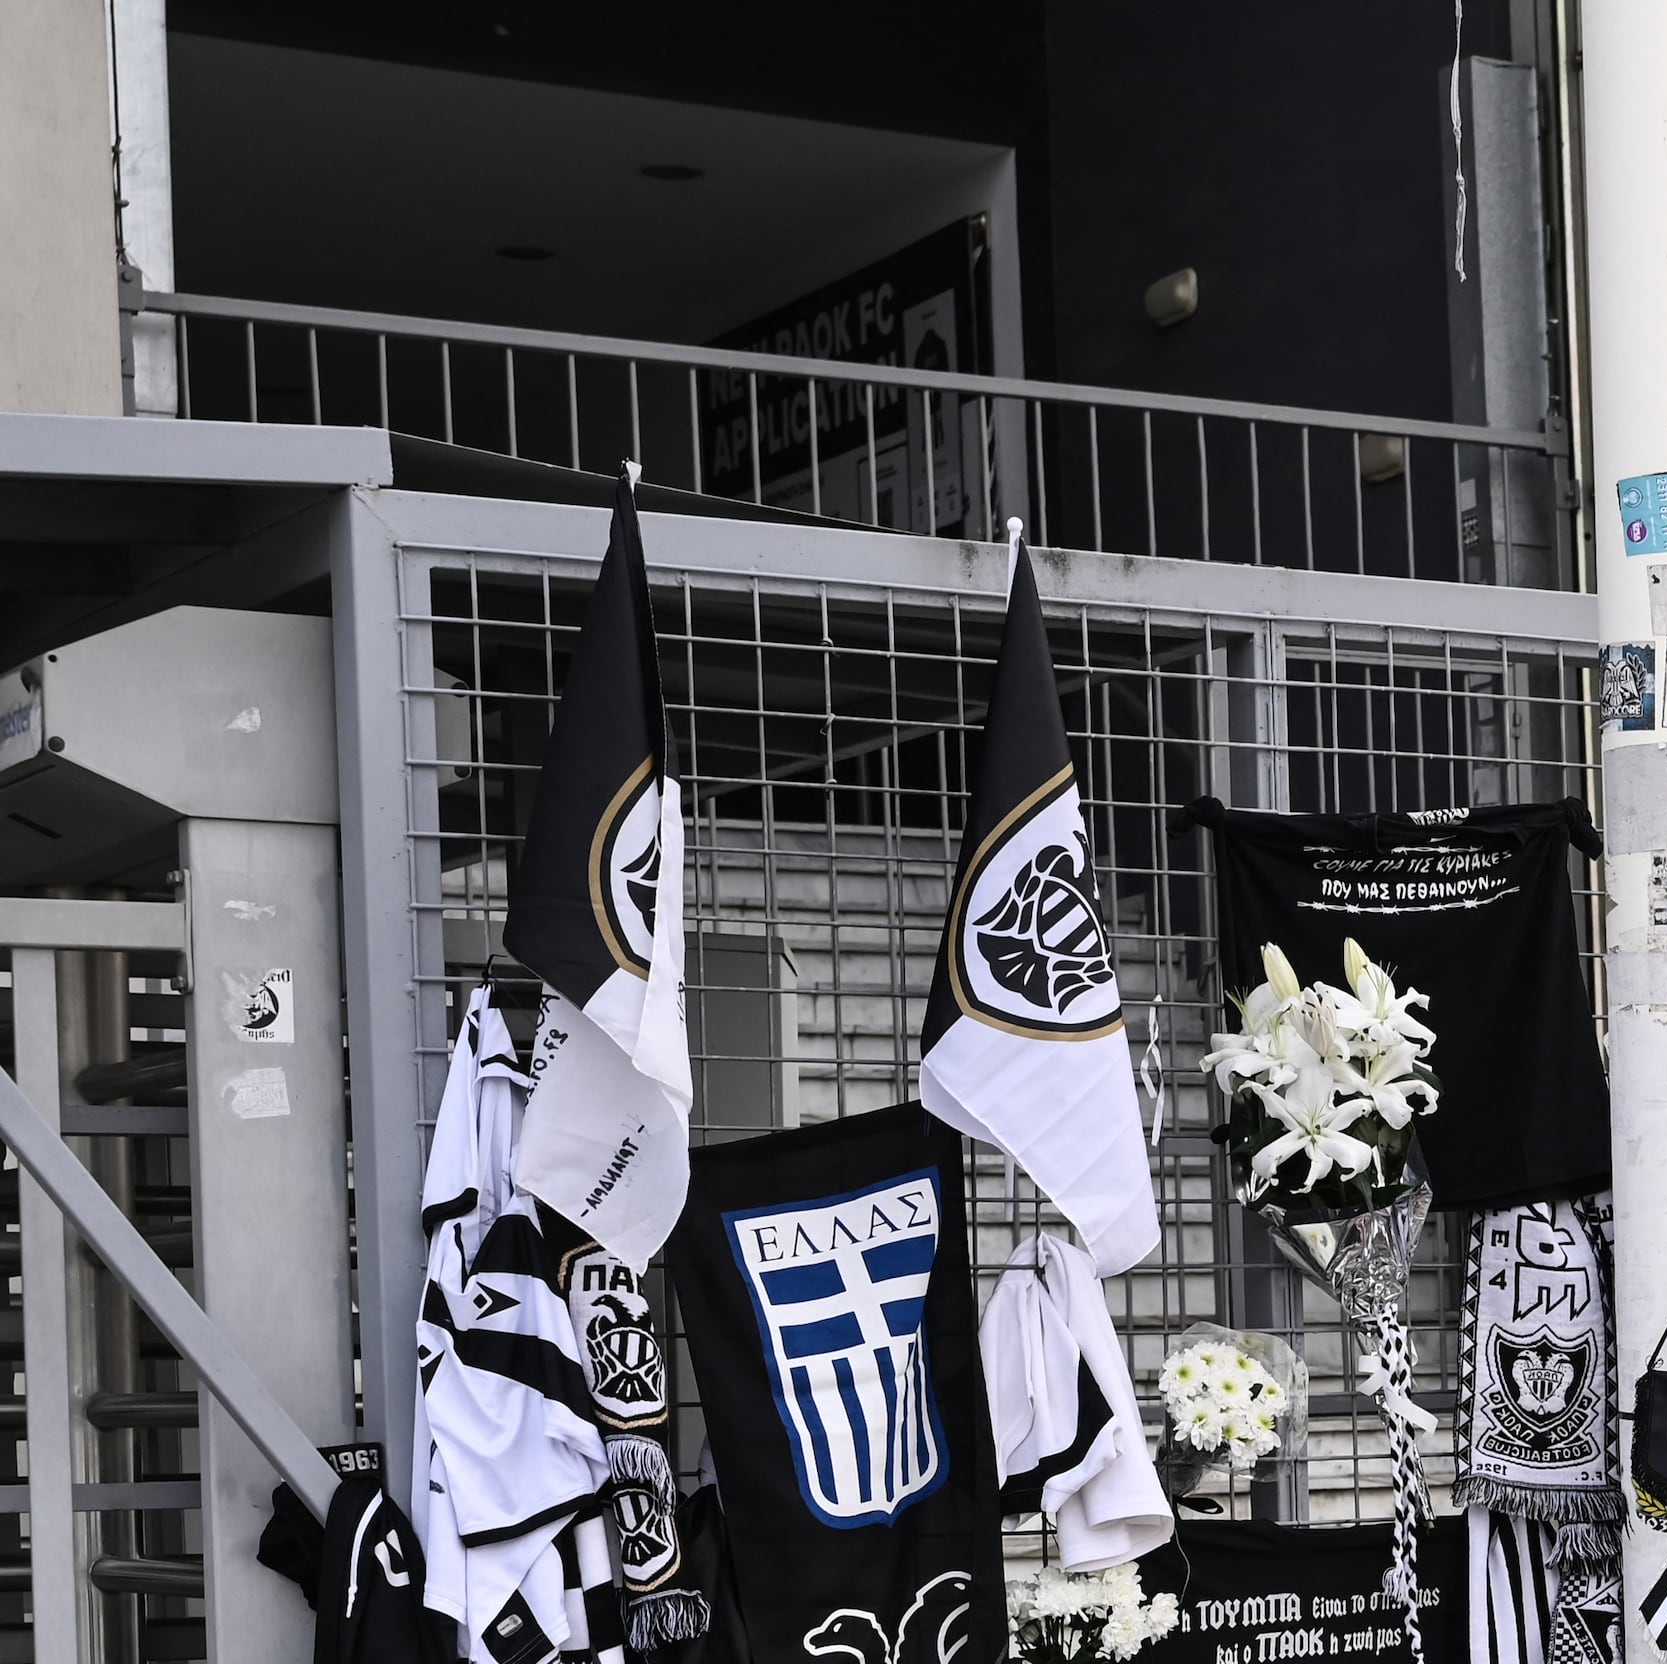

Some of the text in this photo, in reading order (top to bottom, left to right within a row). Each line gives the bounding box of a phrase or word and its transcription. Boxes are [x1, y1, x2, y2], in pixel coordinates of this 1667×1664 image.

[775, 299, 853, 384] PAOK
[858, 281, 895, 347] FC
[1322, 878, 1351, 900] ΠΟΥ
[1357, 882, 1391, 900] ΜΑΣ
[751, 1191, 932, 1264] ΕΛΛΑΣ
[1195, 1592, 1303, 1632] ΤΟΥΜΠΑ
[1254, 1626, 1325, 1664] ΠΑΟΚ
[1376, 1626, 1402, 1656] μας
